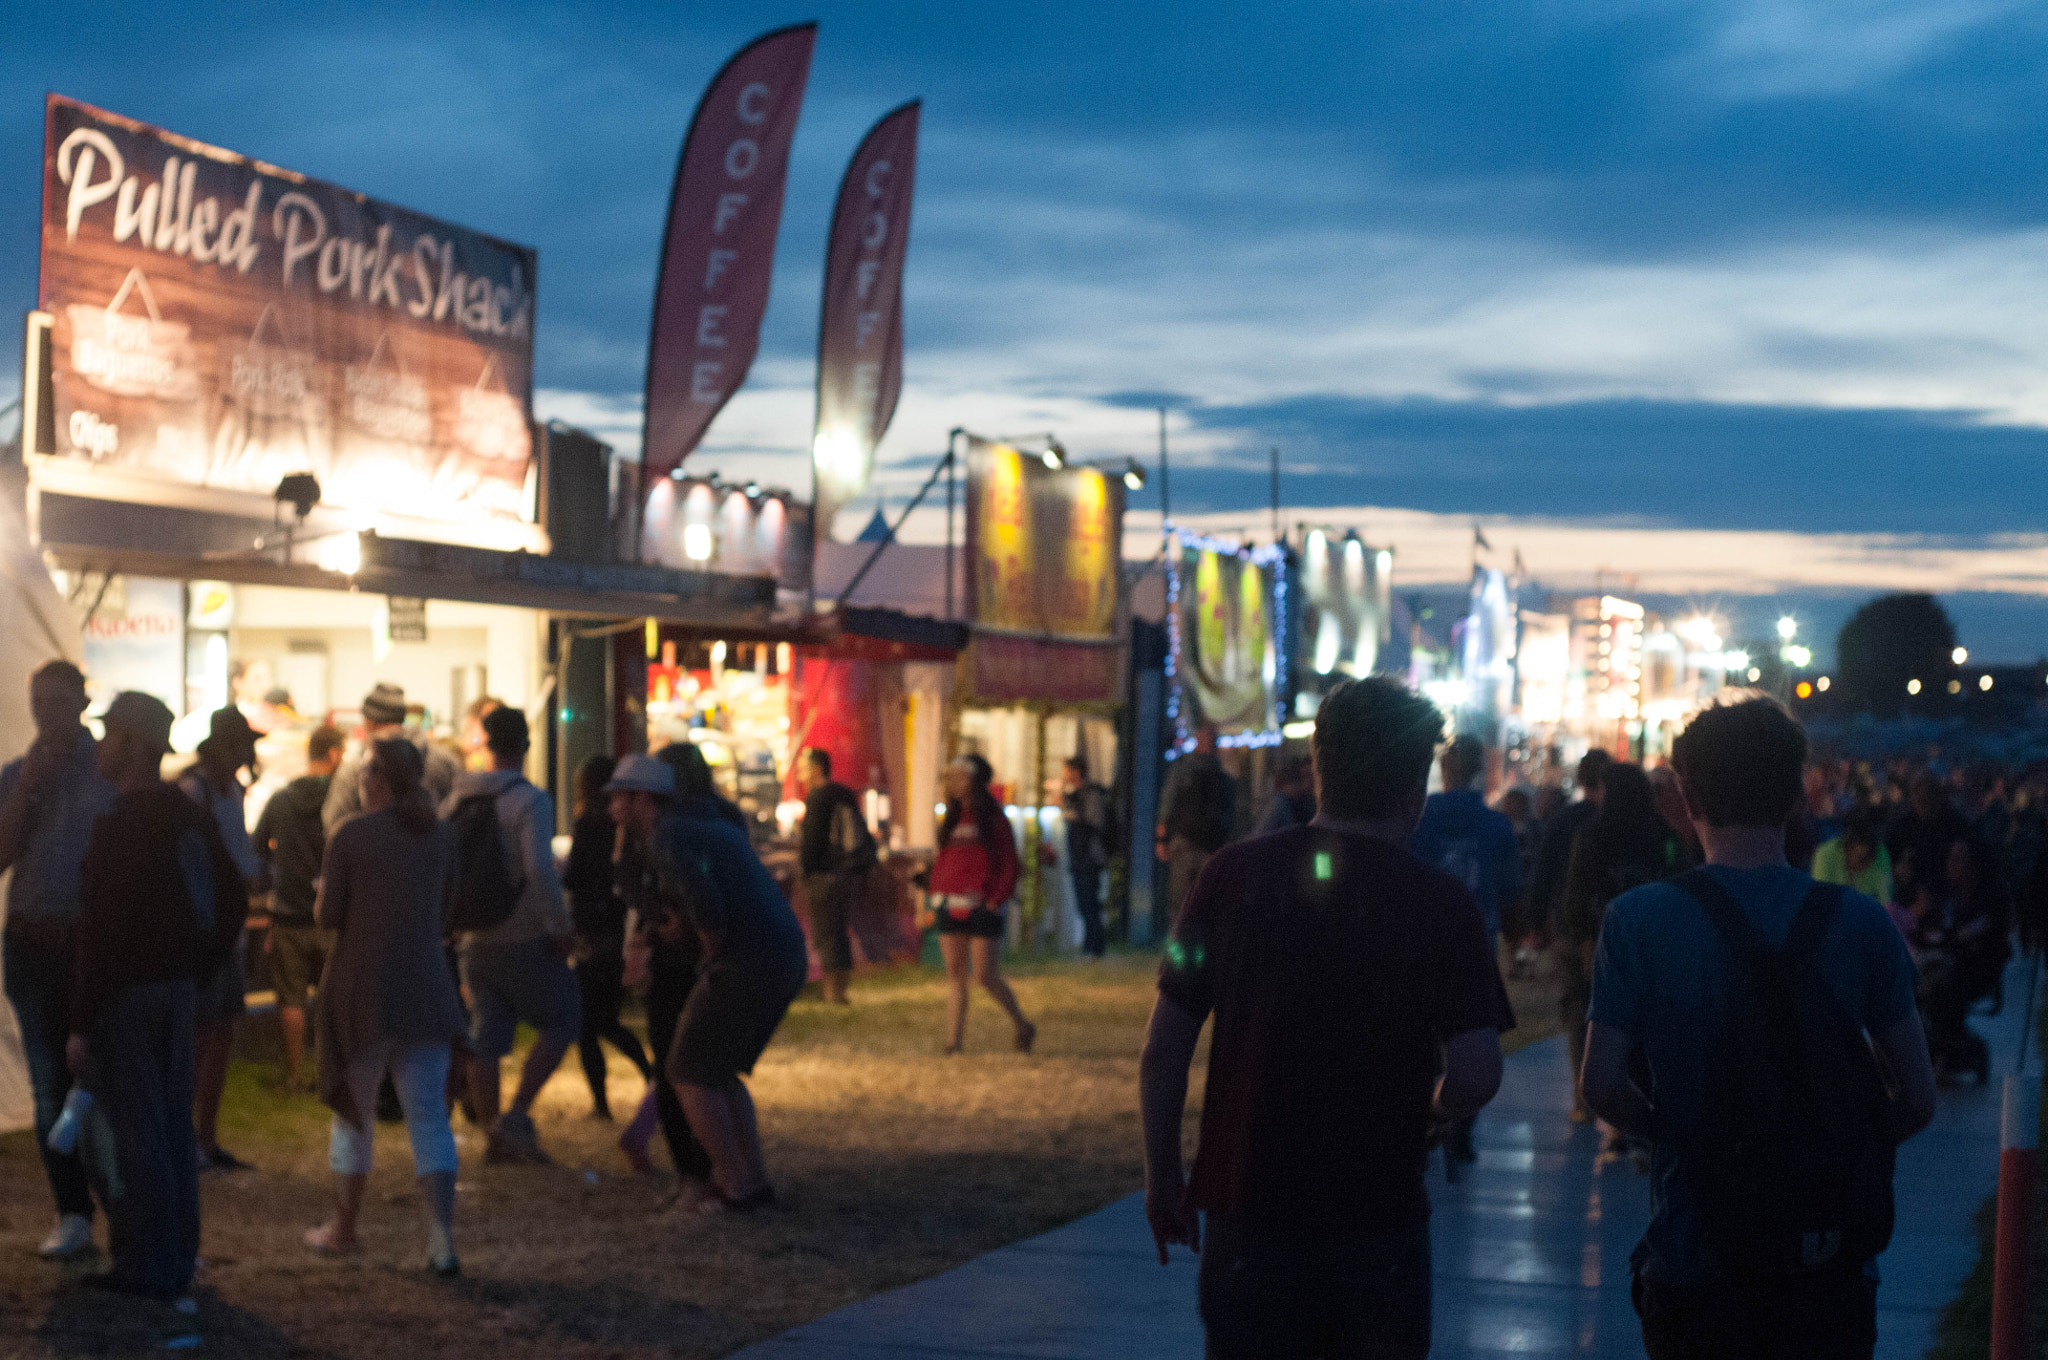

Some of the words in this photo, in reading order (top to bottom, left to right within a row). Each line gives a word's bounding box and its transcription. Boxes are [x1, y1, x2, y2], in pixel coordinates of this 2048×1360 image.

[57, 127, 263, 275] Pulled
[272, 191, 403, 308] Pork
[407, 233, 532, 339] Shack
[692, 82, 769, 402] COFFEE
[850, 160, 891, 432] COFFE
